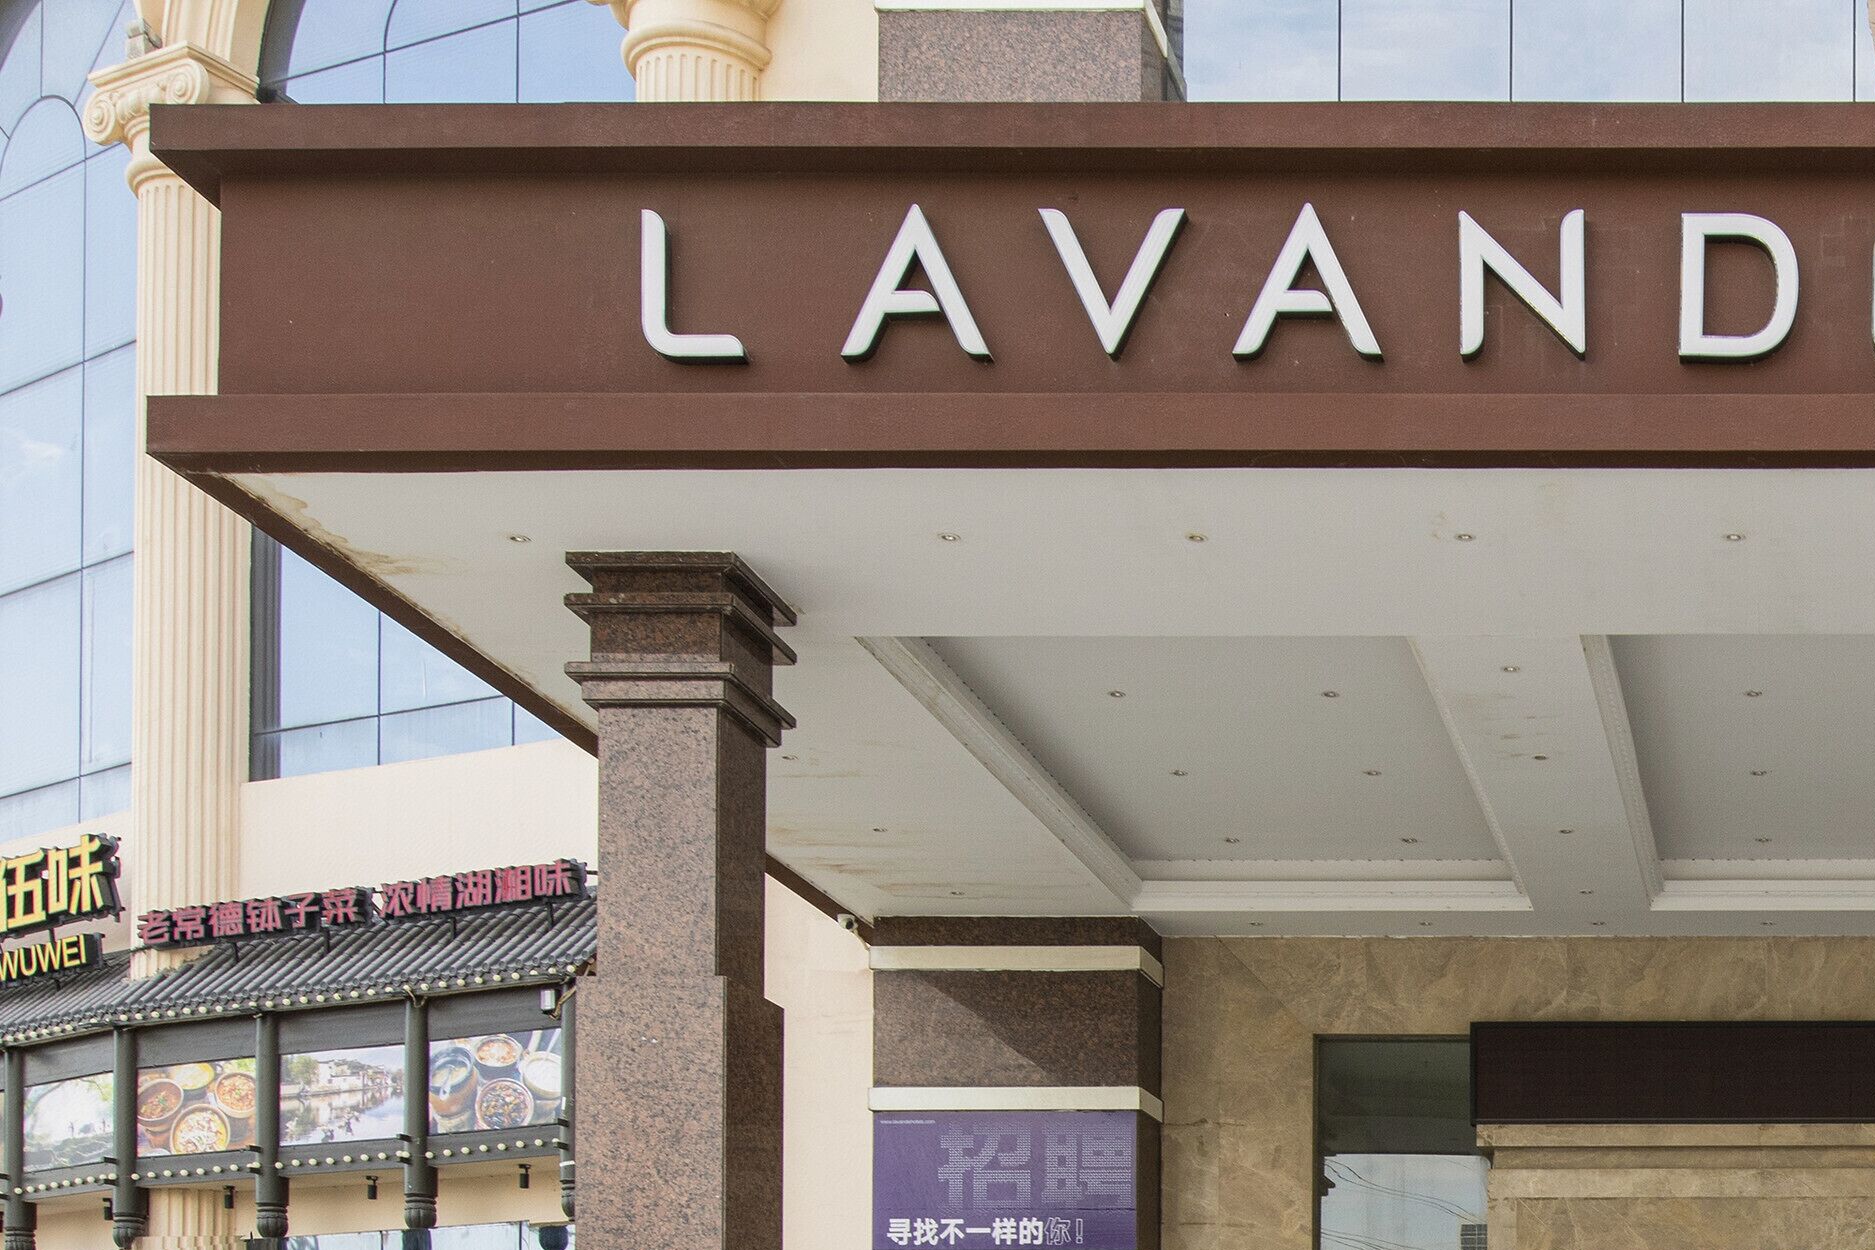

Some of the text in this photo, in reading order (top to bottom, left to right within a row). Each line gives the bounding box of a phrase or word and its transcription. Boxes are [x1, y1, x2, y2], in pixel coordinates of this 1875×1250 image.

[137, 859, 573, 945] 老常德钵子菜 浓情湖湘味
[0, 934, 87, 981] WUWEI
[937, 1121, 1132, 1211] 招聘
